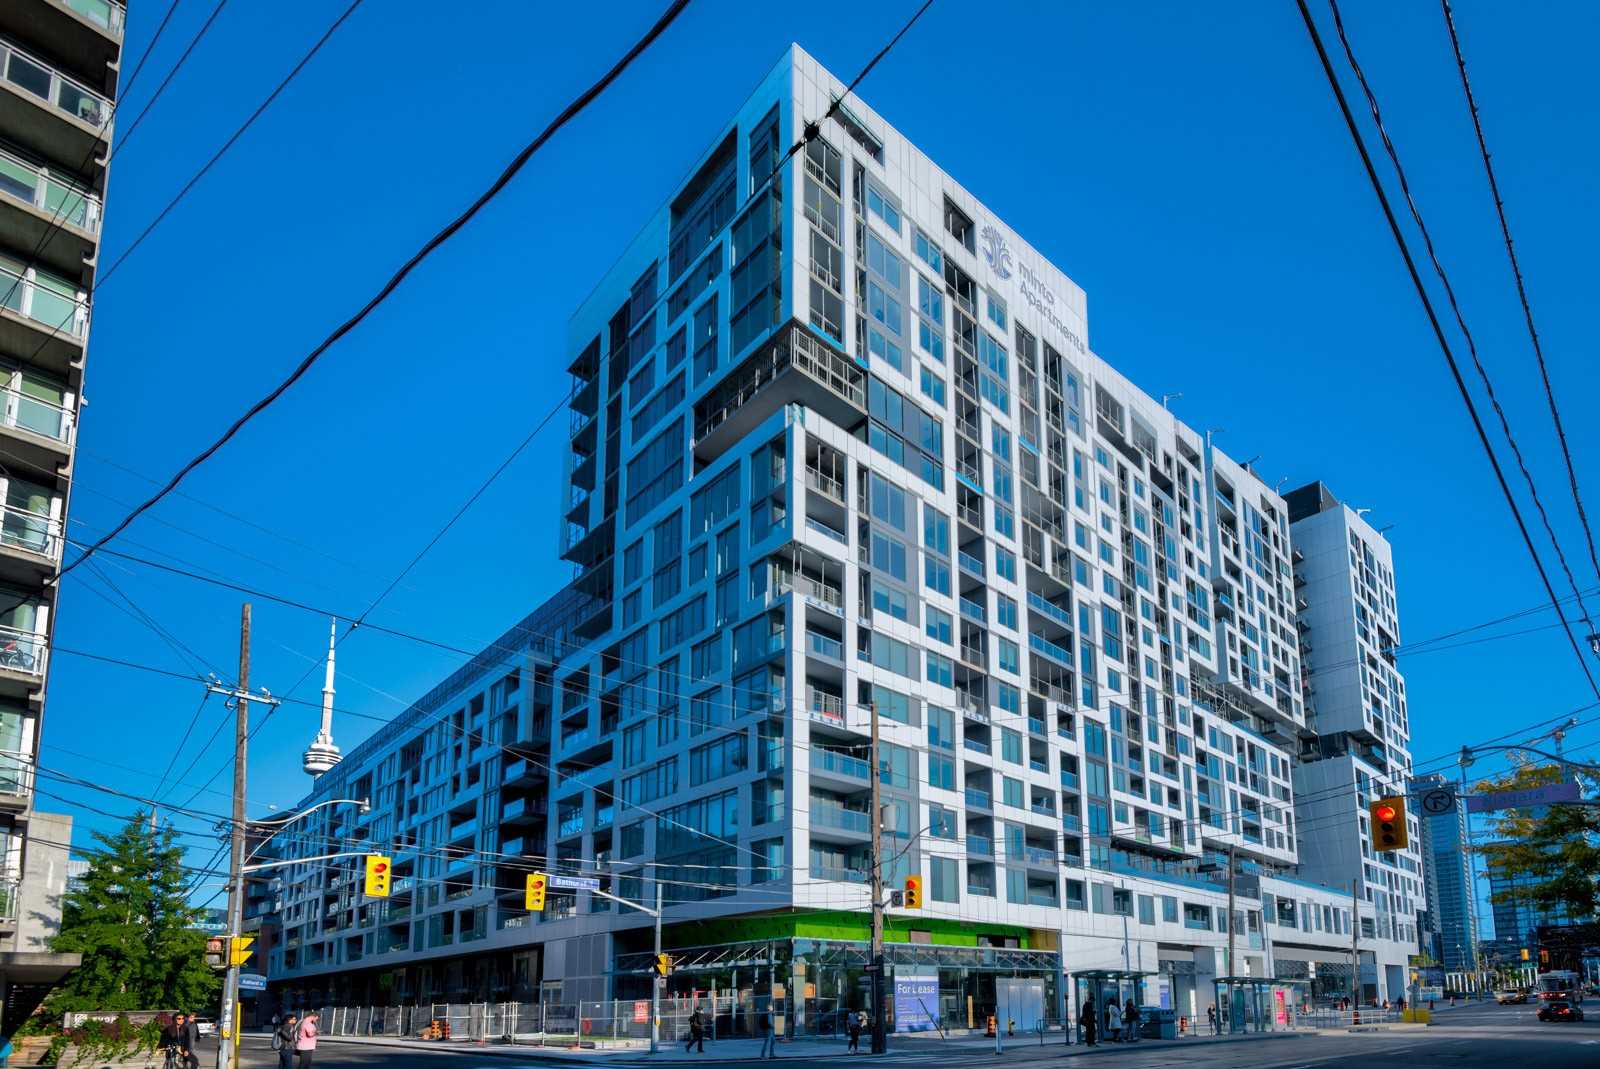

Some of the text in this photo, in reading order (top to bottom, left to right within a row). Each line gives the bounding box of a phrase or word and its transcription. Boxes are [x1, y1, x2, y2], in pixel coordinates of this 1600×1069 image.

[1018, 262, 1055, 305] minto
[1020, 281, 1086, 354] Apartments
[897, 983, 936, 994] For Lease
